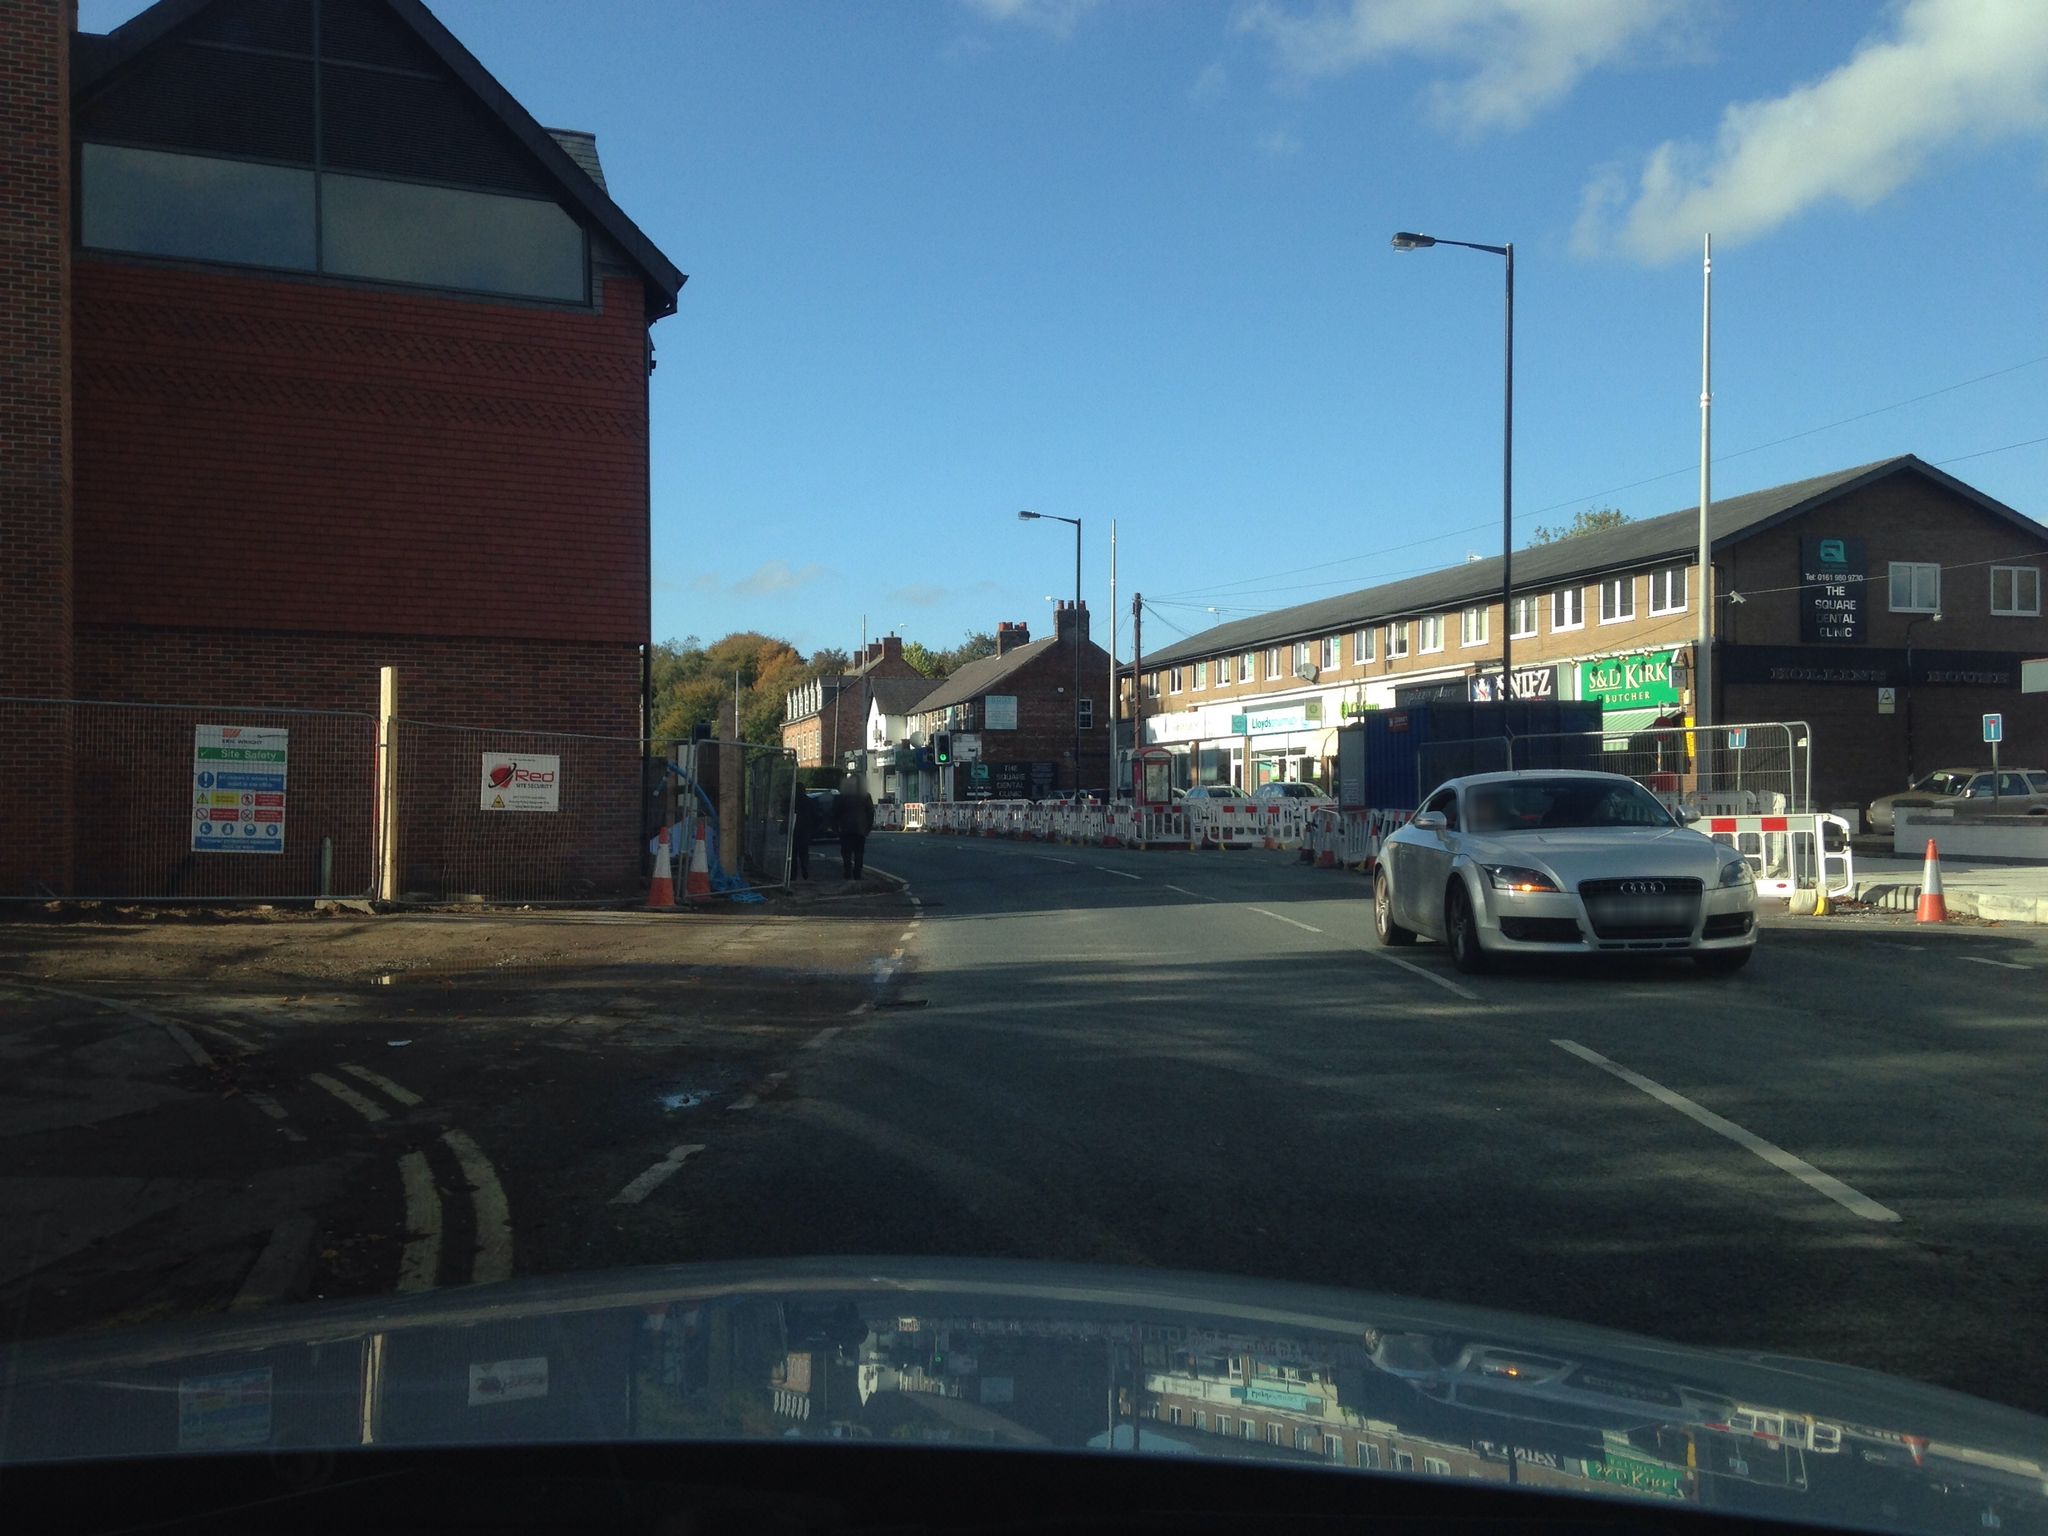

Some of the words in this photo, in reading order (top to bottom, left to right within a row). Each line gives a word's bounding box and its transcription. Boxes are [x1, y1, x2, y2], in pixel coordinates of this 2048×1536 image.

[1825, 586, 1845, 596] THE
[1814, 599, 1857, 610] SQUARE
[1816, 613, 1856, 624] DENTAL
[1819, 627, 1853, 637] CLINIC
[1588, 668, 1621, 689] S&D
[1625, 662, 1668, 689] KIRK
[1605, 691, 1650, 704] BUTCHER
[221, 750, 240, 759] Site
[245, 751, 277, 761] Safety
[515, 769, 555, 783] Red
[996, 781, 1024, 789] DENTAL
